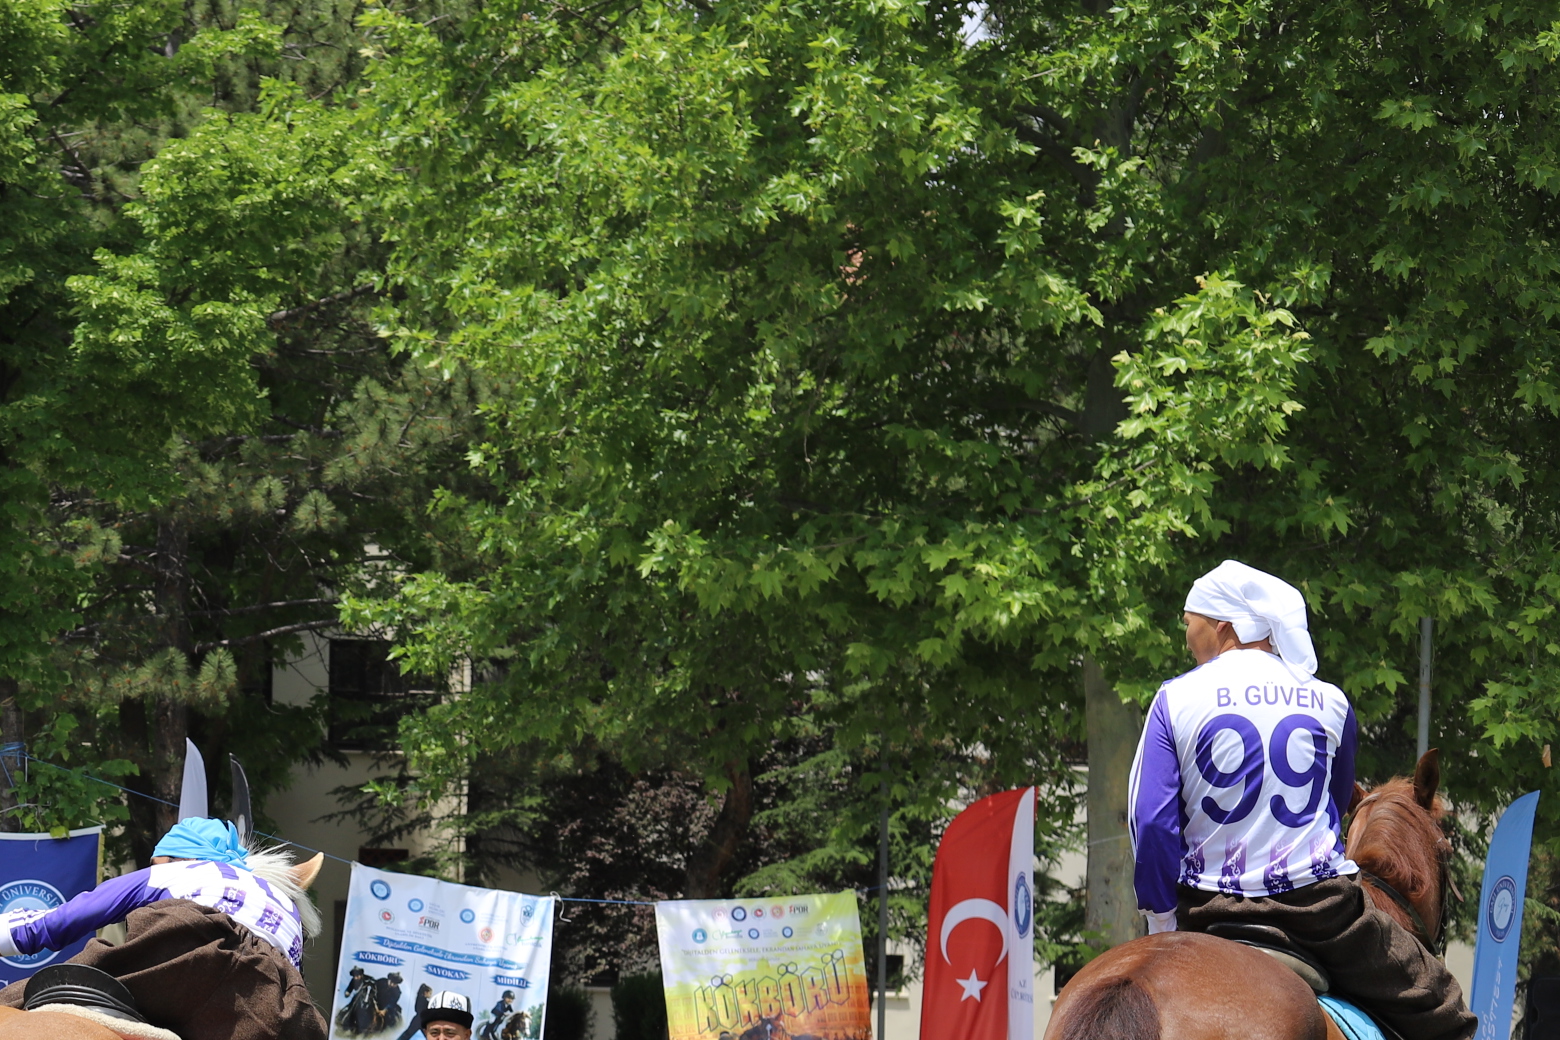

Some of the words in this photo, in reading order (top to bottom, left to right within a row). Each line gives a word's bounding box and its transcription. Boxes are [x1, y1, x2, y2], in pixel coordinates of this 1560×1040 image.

[1216, 687, 1237, 708] B.
[1244, 681, 1324, 711] GÜVEN
[1195, 713, 1328, 829] 99
[427, 965, 465, 979] SAYOKAN
[694, 949, 850, 1034] KÖKBÖRÜ
